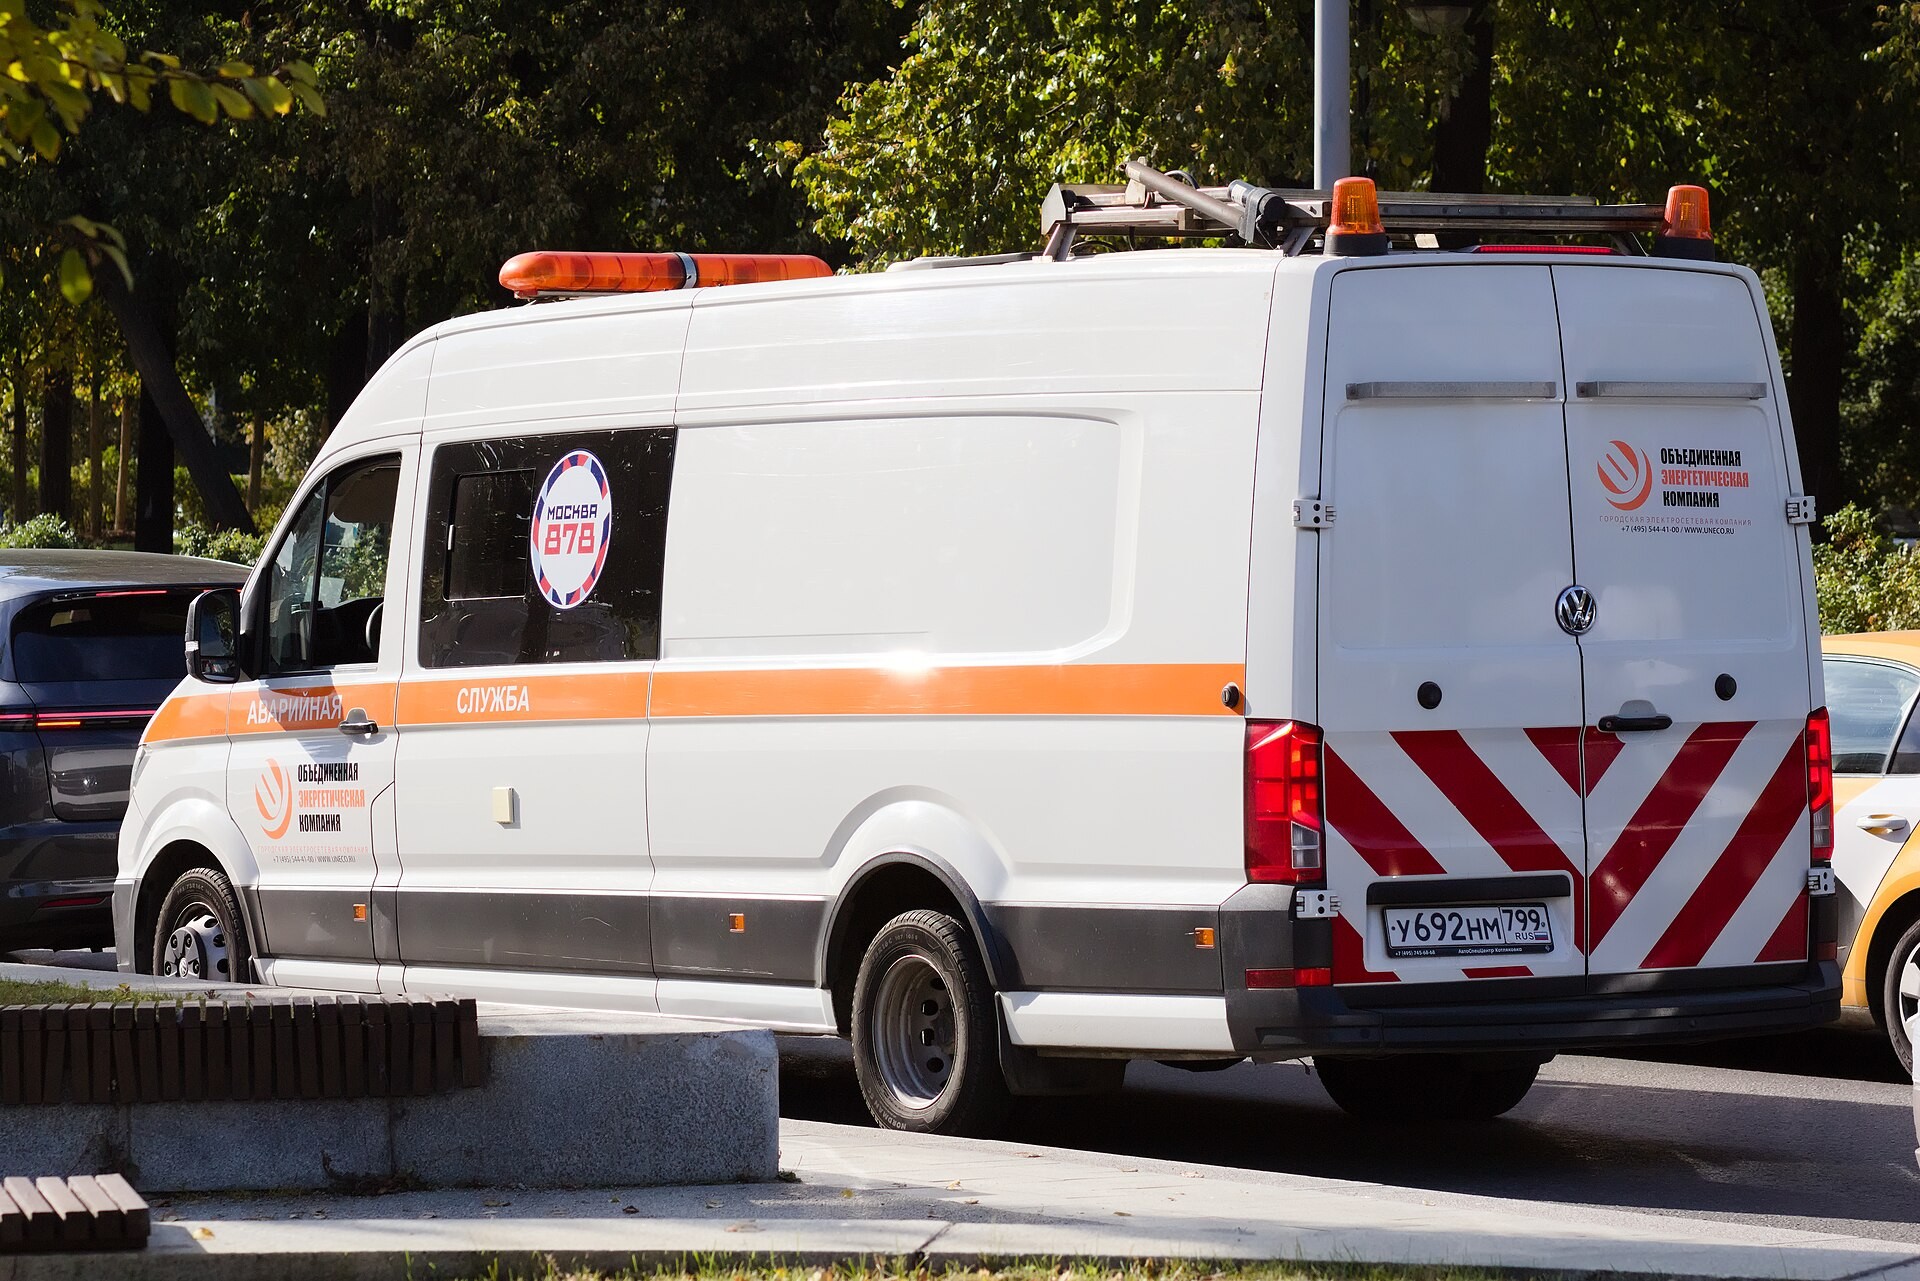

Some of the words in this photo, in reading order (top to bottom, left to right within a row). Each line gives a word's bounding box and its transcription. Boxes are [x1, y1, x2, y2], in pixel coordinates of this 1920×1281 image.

[1660, 448, 1742, 467] ОБЪЕДИНЕННАЯ
[1661, 469, 1750, 488] ЭНЕРГЕТИЧЕСКАЯ
[1662, 490, 1720, 508] КОМПАНИЯ
[547, 503, 598, 521] МОСКВА
[1599, 515, 1645, 523] ГОРОДСКАЯ
[1646, 516, 1714, 525] ЭЛЕКТРОСЕТЕВАЯ
[1715, 518, 1752, 526] КОМПАНИЯ
[544, 522, 596, 556] 878
[1630, 525, 1648, 534] (495)
[1684, 526, 1735, 535] WWW.UNECO.RU
[247, 690, 343, 725] АВАРИЙНАЯ
[456, 685, 530, 714] СЛУЖБА
[297, 763, 359, 785] ОБЪЕДИНЕННАЯ
[298, 789, 366, 808] ЭНЕРГЕТИЧЕСКАЯ
[299, 813, 342, 833] КОМПАНИЯ
[1396, 911, 1502, 943] У692НМ
[1501, 908, 1541, 932] 799
[1514, 931, 1535, 941] RUS
